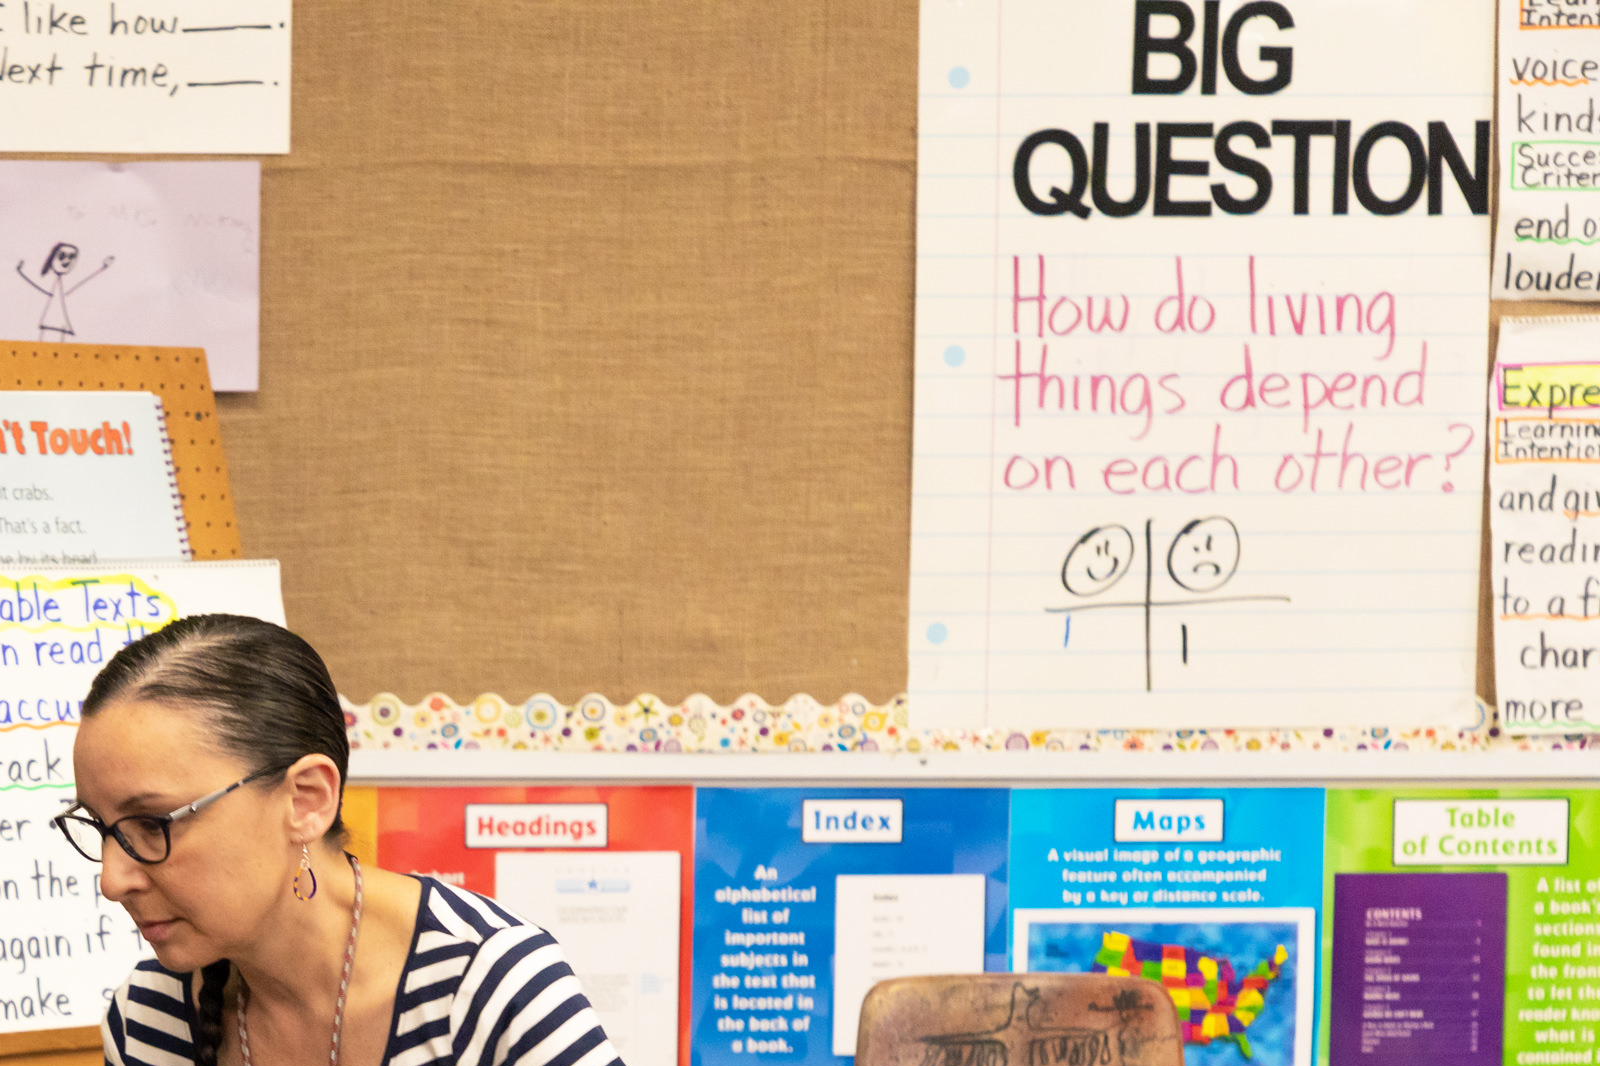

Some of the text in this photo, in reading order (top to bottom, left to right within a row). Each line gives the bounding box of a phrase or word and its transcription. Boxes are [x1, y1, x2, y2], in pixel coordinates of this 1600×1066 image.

[24, 1, 87, 34] like
[1132, 0, 1296, 95] BIG
[1013, 119, 1491, 220] QUESTION
[1515, 202, 1569, 239] end
[1013, 254, 1396, 360] How do living
[997, 340, 1424, 440] things depend
[30, 420, 133, 455] Touch!
[1004, 422, 1474, 493] on each other?
[12, 484, 53, 500] crabs.
[1500, 474, 1554, 513] and
[42, 522, 52, 534] a
[54, 518, 86, 534] fact.
[71, 580, 161, 623] Texts
[1500, 576, 1564, 617] to a
[35, 627, 103, 666] read
[1505, 699, 1583, 721] more
[815, 811, 891, 830] Index
[1133, 811, 1205, 834] Maps
[1446, 807, 1515, 828] Table
[478, 816, 597, 839] Headings
[1403, 835, 1557, 856] of Contents
[1063, 848, 1281, 864] visual image geographic
[31, 860, 79, 897] the
[754, 865, 777, 880] An
[1063, 869, 1266, 884] feature often accompanied
[715, 887, 816, 904] alphabetical
[1100, 889, 1264, 905] key distance scale.
[742, 908, 767, 924] list
[1366, 908, 1422, 921] CONTENTS
[86, 915, 112, 952] if
[725, 930, 805, 947] important
[1534, 942, 1581, 957] found
[721, 952, 788, 969] subjects
[745, 974, 776, 988] text
[732, 995, 793, 1010] located
[749, 1016, 788, 1031] back
[1519, 1008, 1567, 1021] reader
[747, 1038, 793, 1053] book.
[1535, 1029, 1575, 1043] what
[1517, 1050, 1592, 1065] contained
